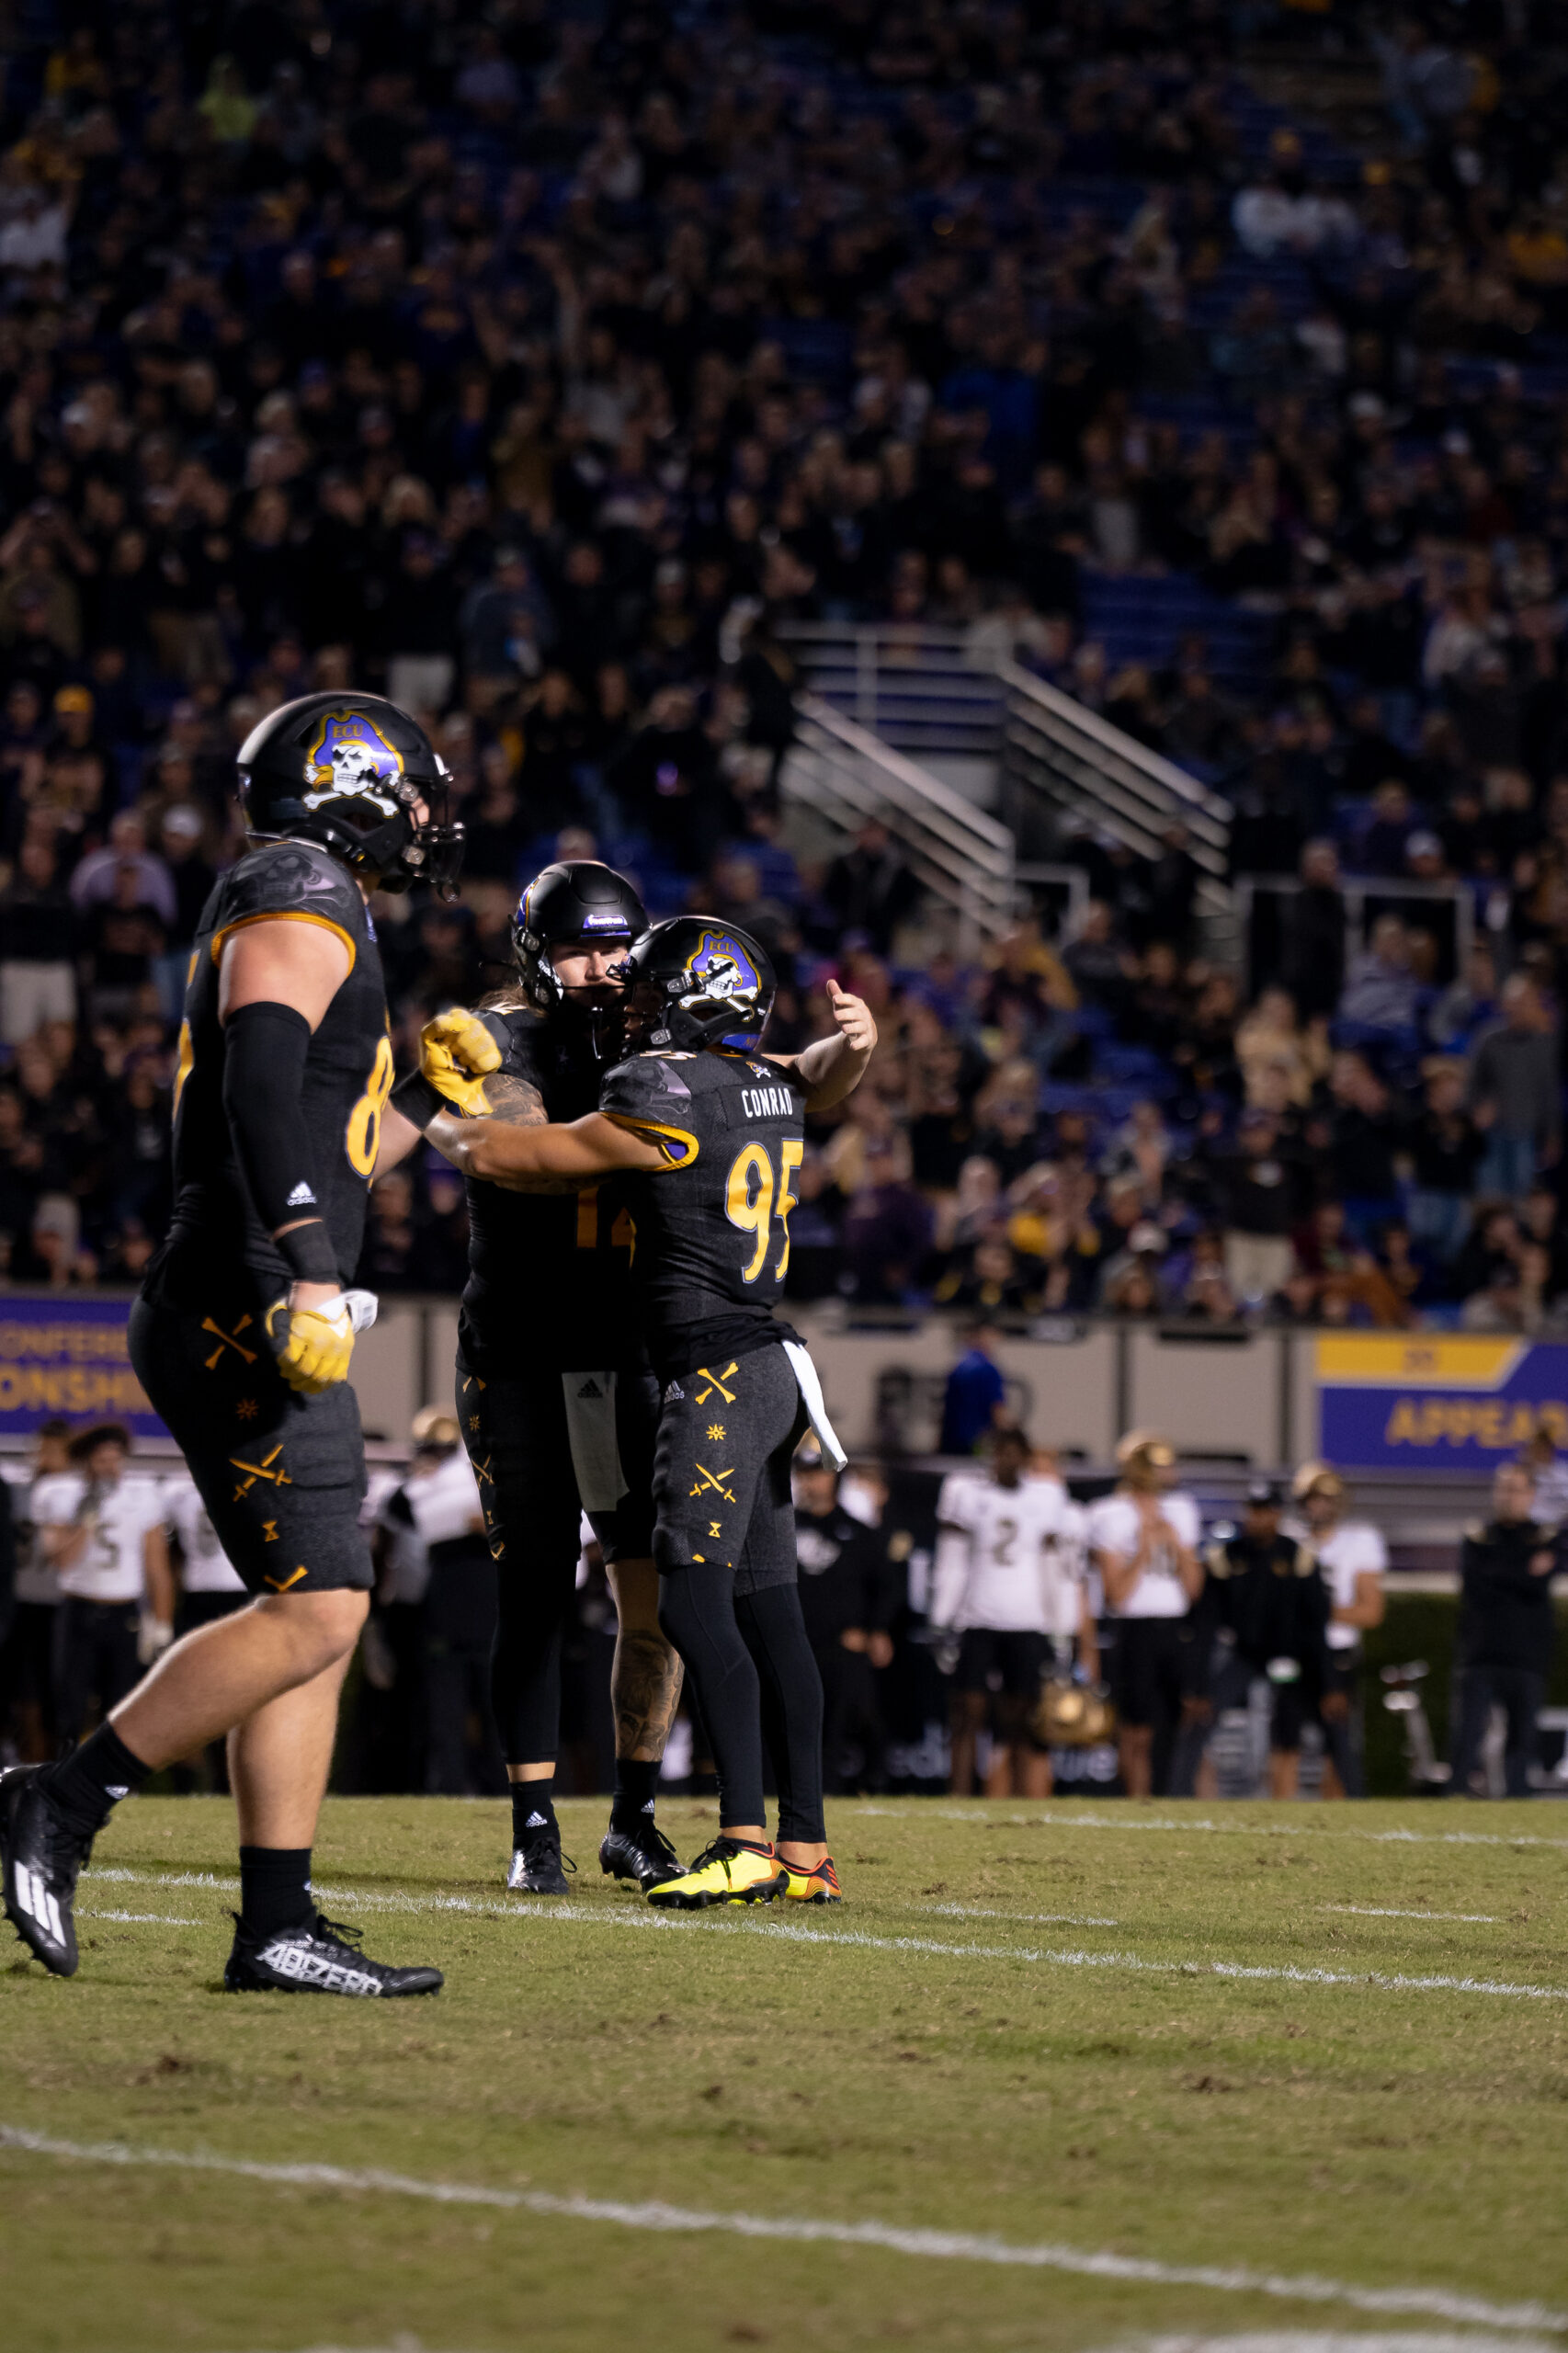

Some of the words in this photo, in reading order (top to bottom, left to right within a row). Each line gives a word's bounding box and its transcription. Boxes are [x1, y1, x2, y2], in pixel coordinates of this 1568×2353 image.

[332, 724, 364, 738] ECU
[709, 940, 734, 953] ECU
[741, 1087, 793, 1119] CONRAD
[725, 1138, 804, 1284] 95
[525, 1818, 548, 1829] adidas
